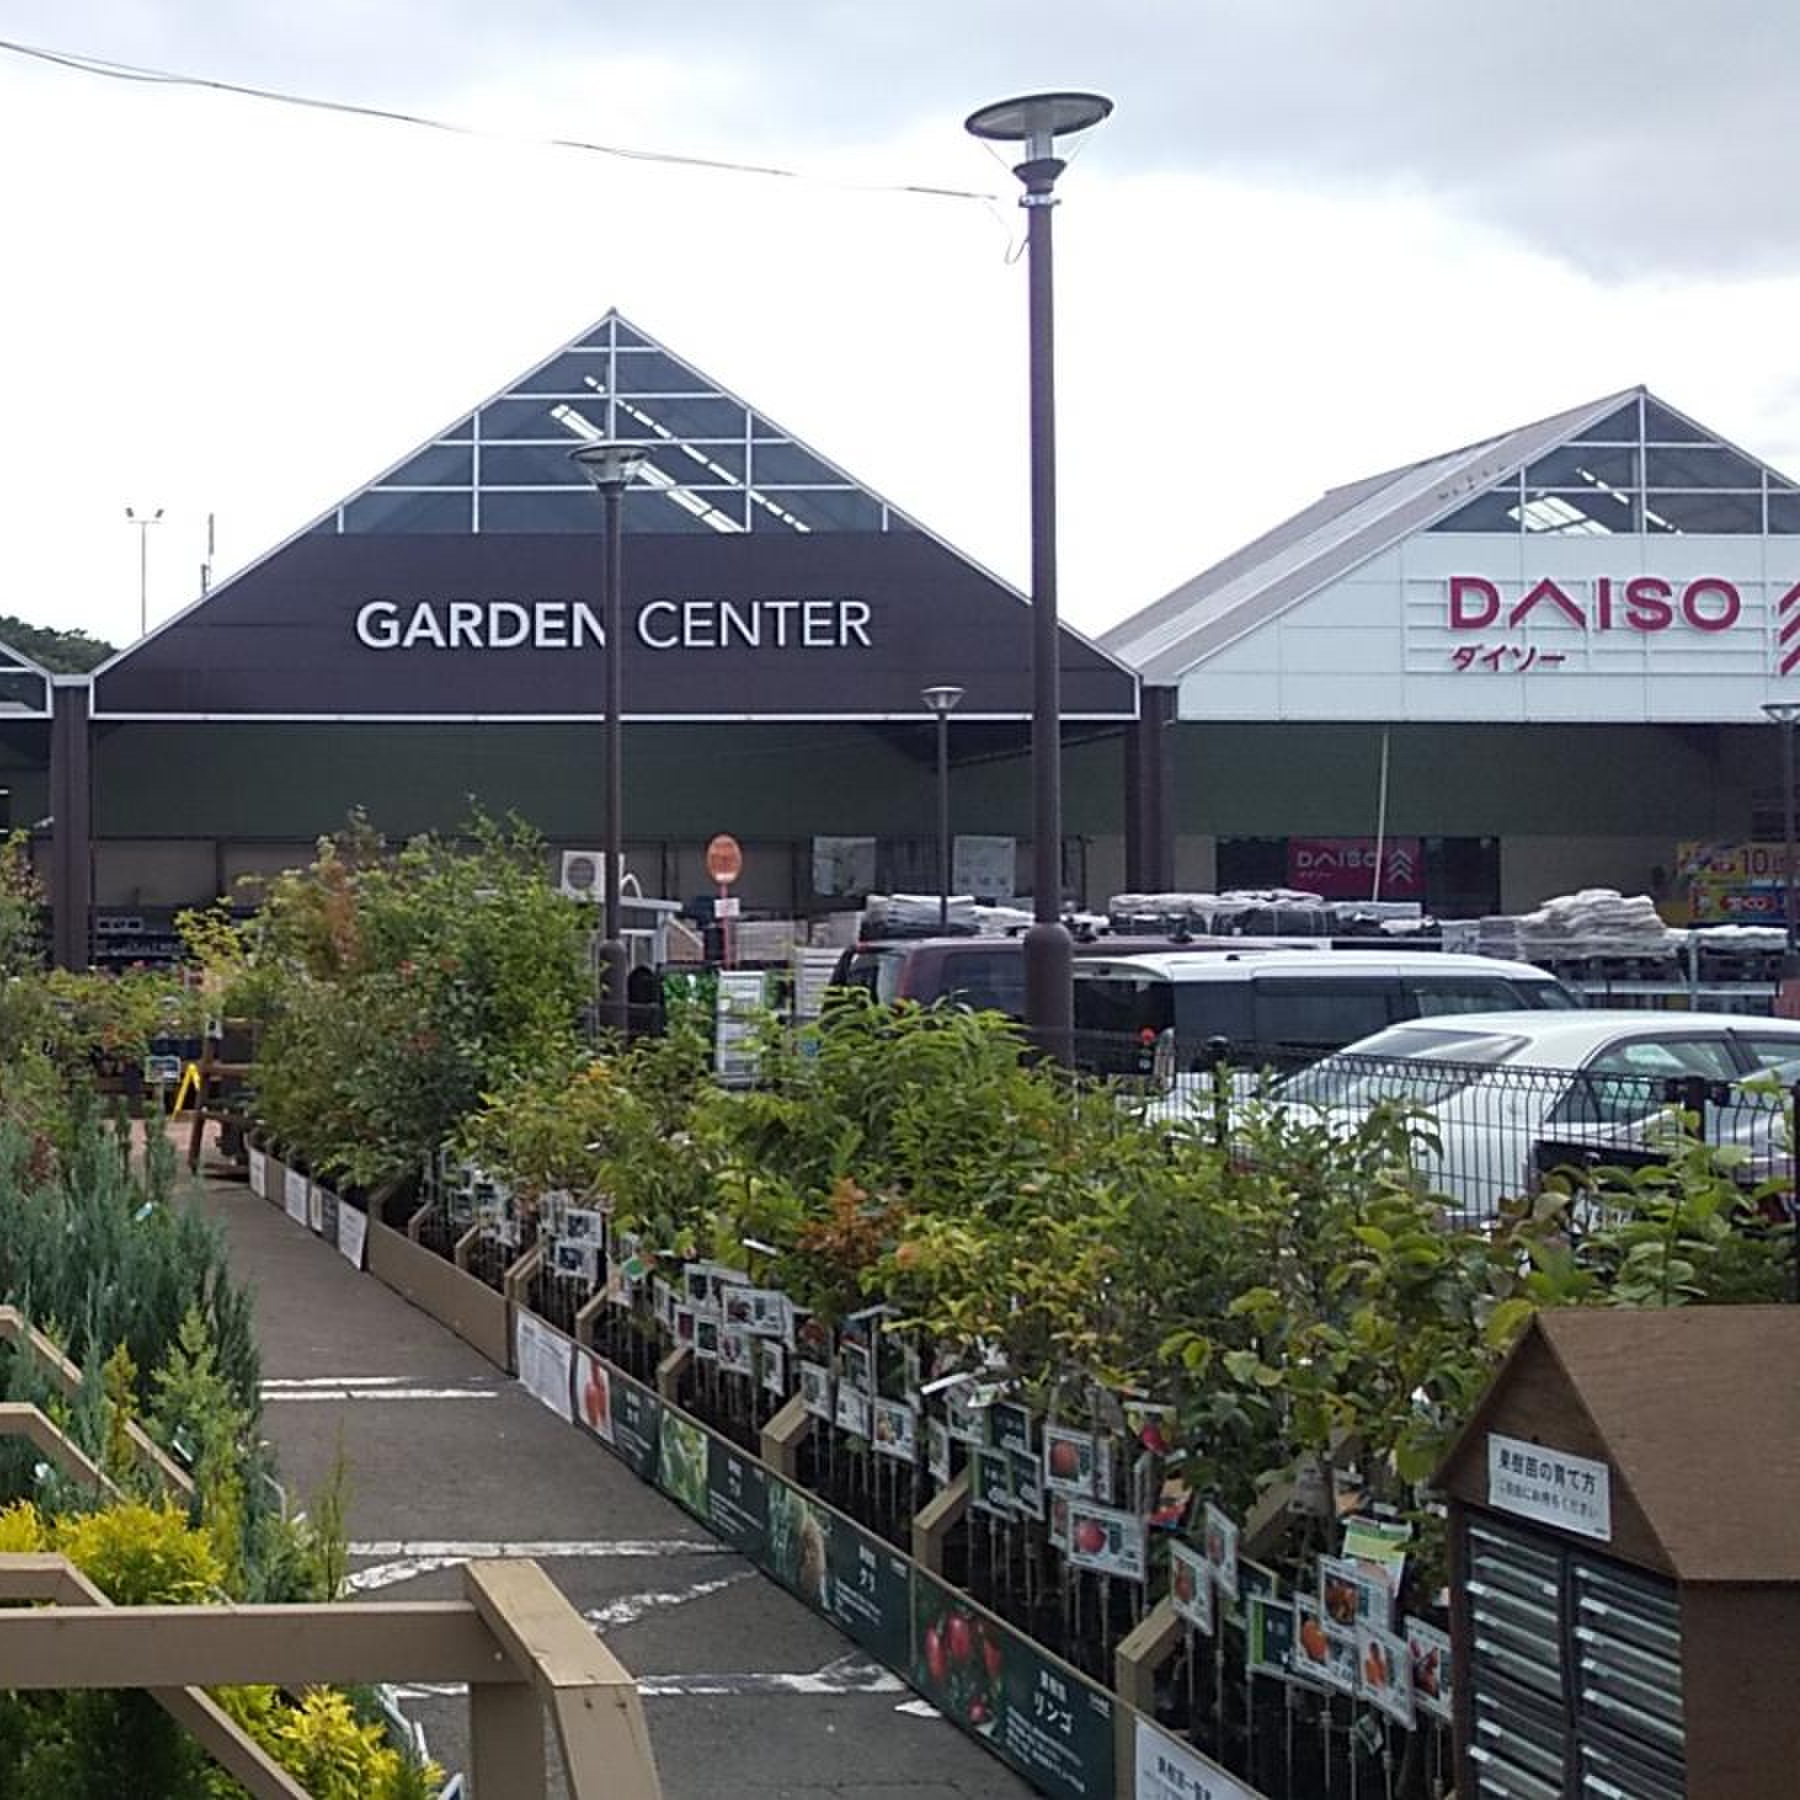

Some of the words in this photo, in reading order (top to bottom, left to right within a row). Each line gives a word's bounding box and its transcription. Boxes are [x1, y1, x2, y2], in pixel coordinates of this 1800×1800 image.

[355, 600, 606, 649] GARDEN
[636, 600, 873, 648] CENTER
[1449, 577, 1742, 632] DAISO
[1451, 643, 1566, 673] ダイソー
[1033, 1691, 1073, 1735] リンゴ
